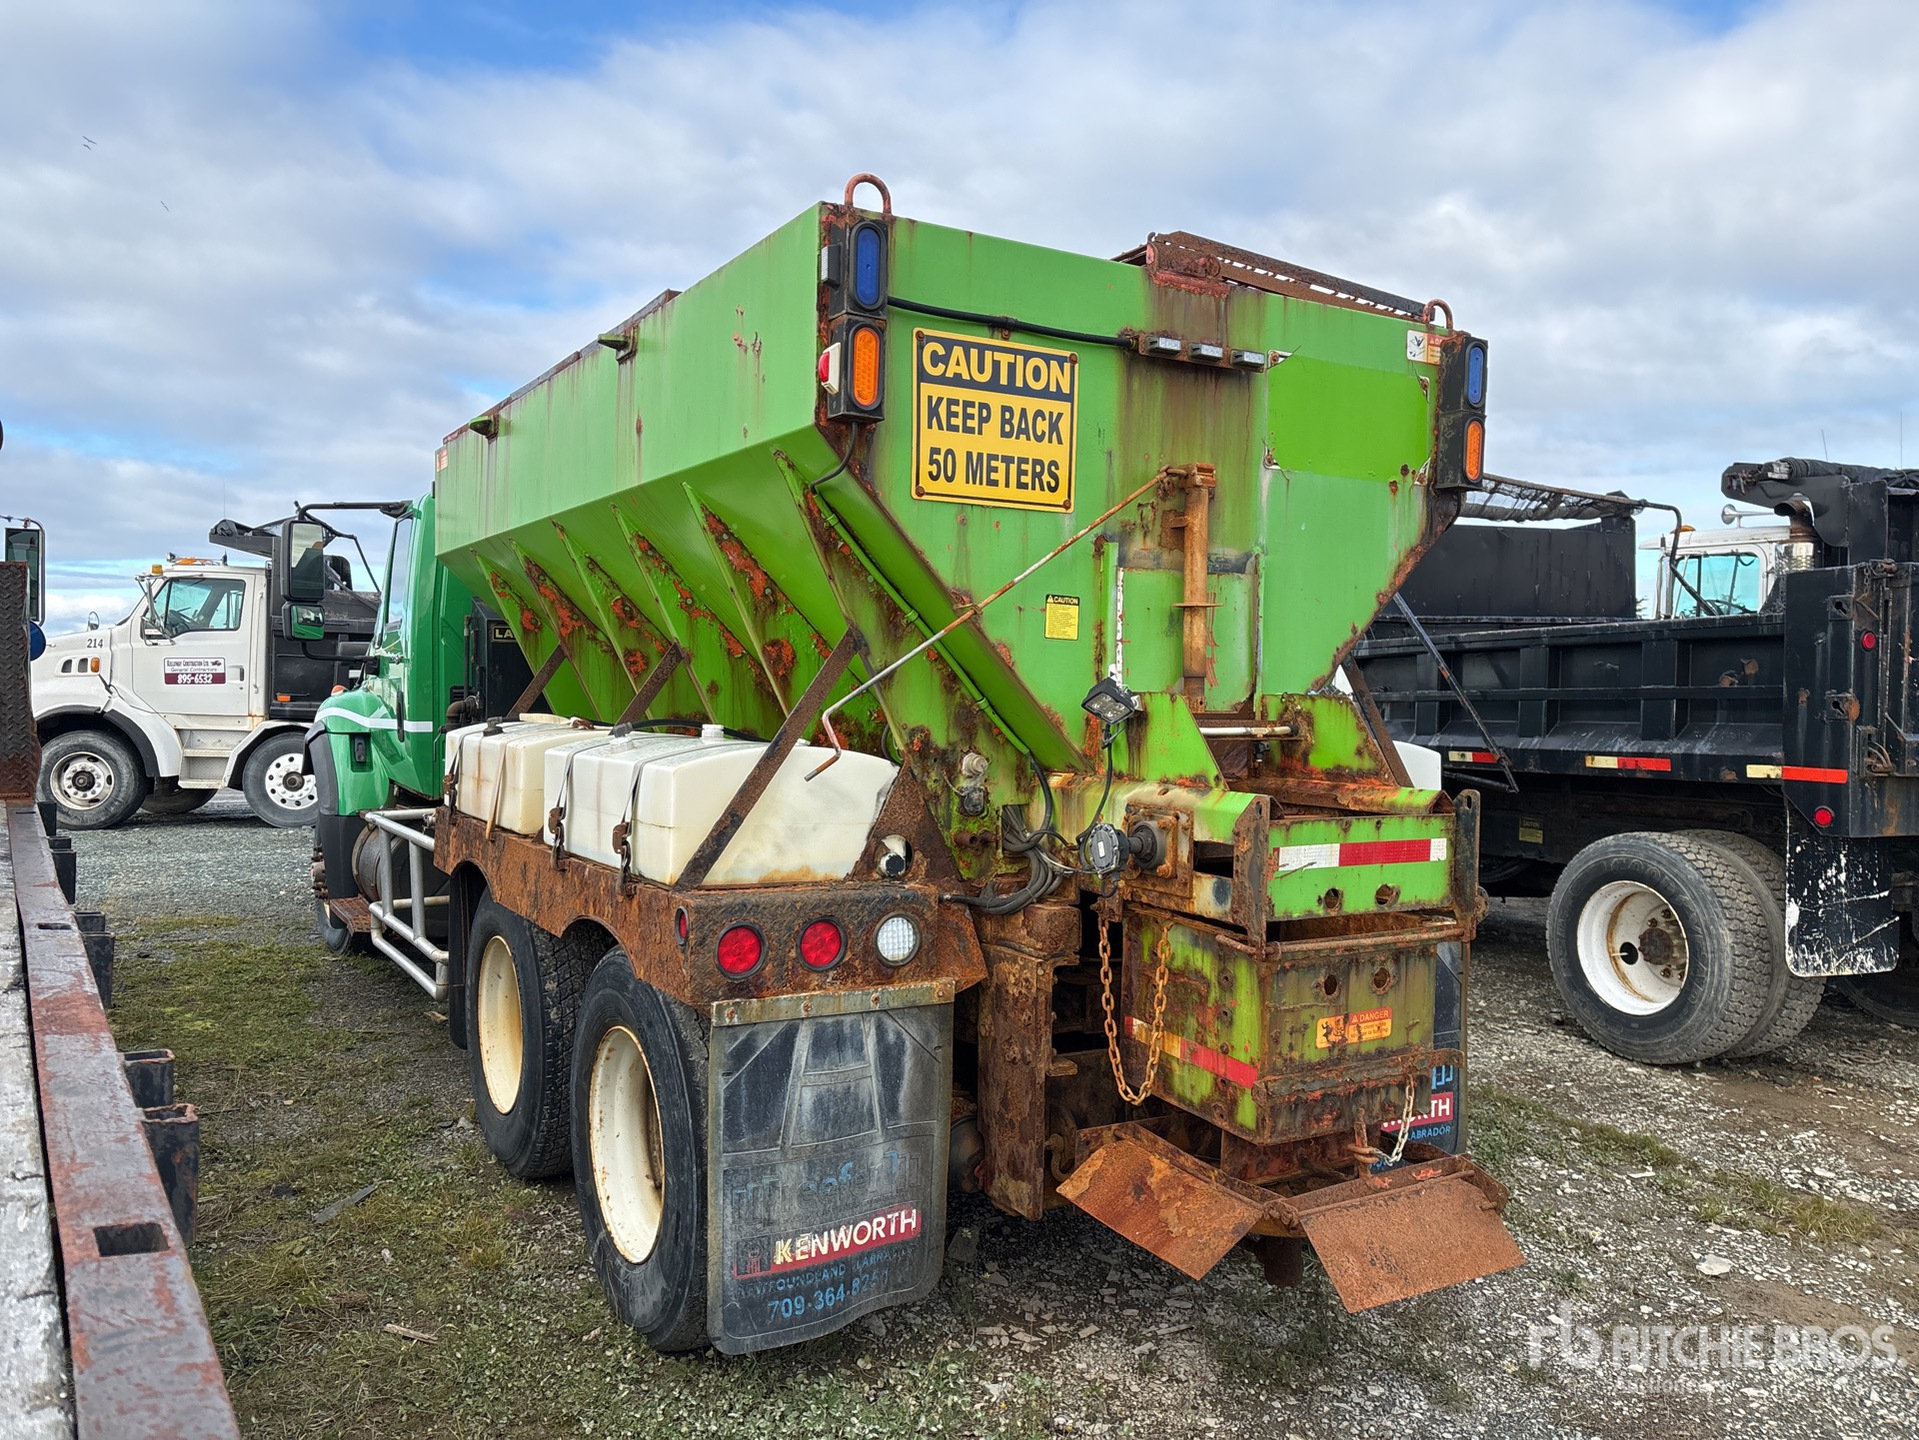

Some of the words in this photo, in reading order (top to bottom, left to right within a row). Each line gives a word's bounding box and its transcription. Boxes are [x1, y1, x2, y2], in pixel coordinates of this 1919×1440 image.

[922, 341, 1071, 395] CAUTION
[926, 394, 992, 436] KEEP
[1000, 404, 1064, 446] BACK
[927, 446, 957, 483] 50
[964, 450, 1060, 494] METERS
[1053, 596, 1079, 605] CAUTION
[86, 638, 104, 649] 214
[177, 673, 213, 684] 895-6532
[1359, 1009, 1389, 1022] DANGER
[773, 1208, 917, 1265] KENWORTH
